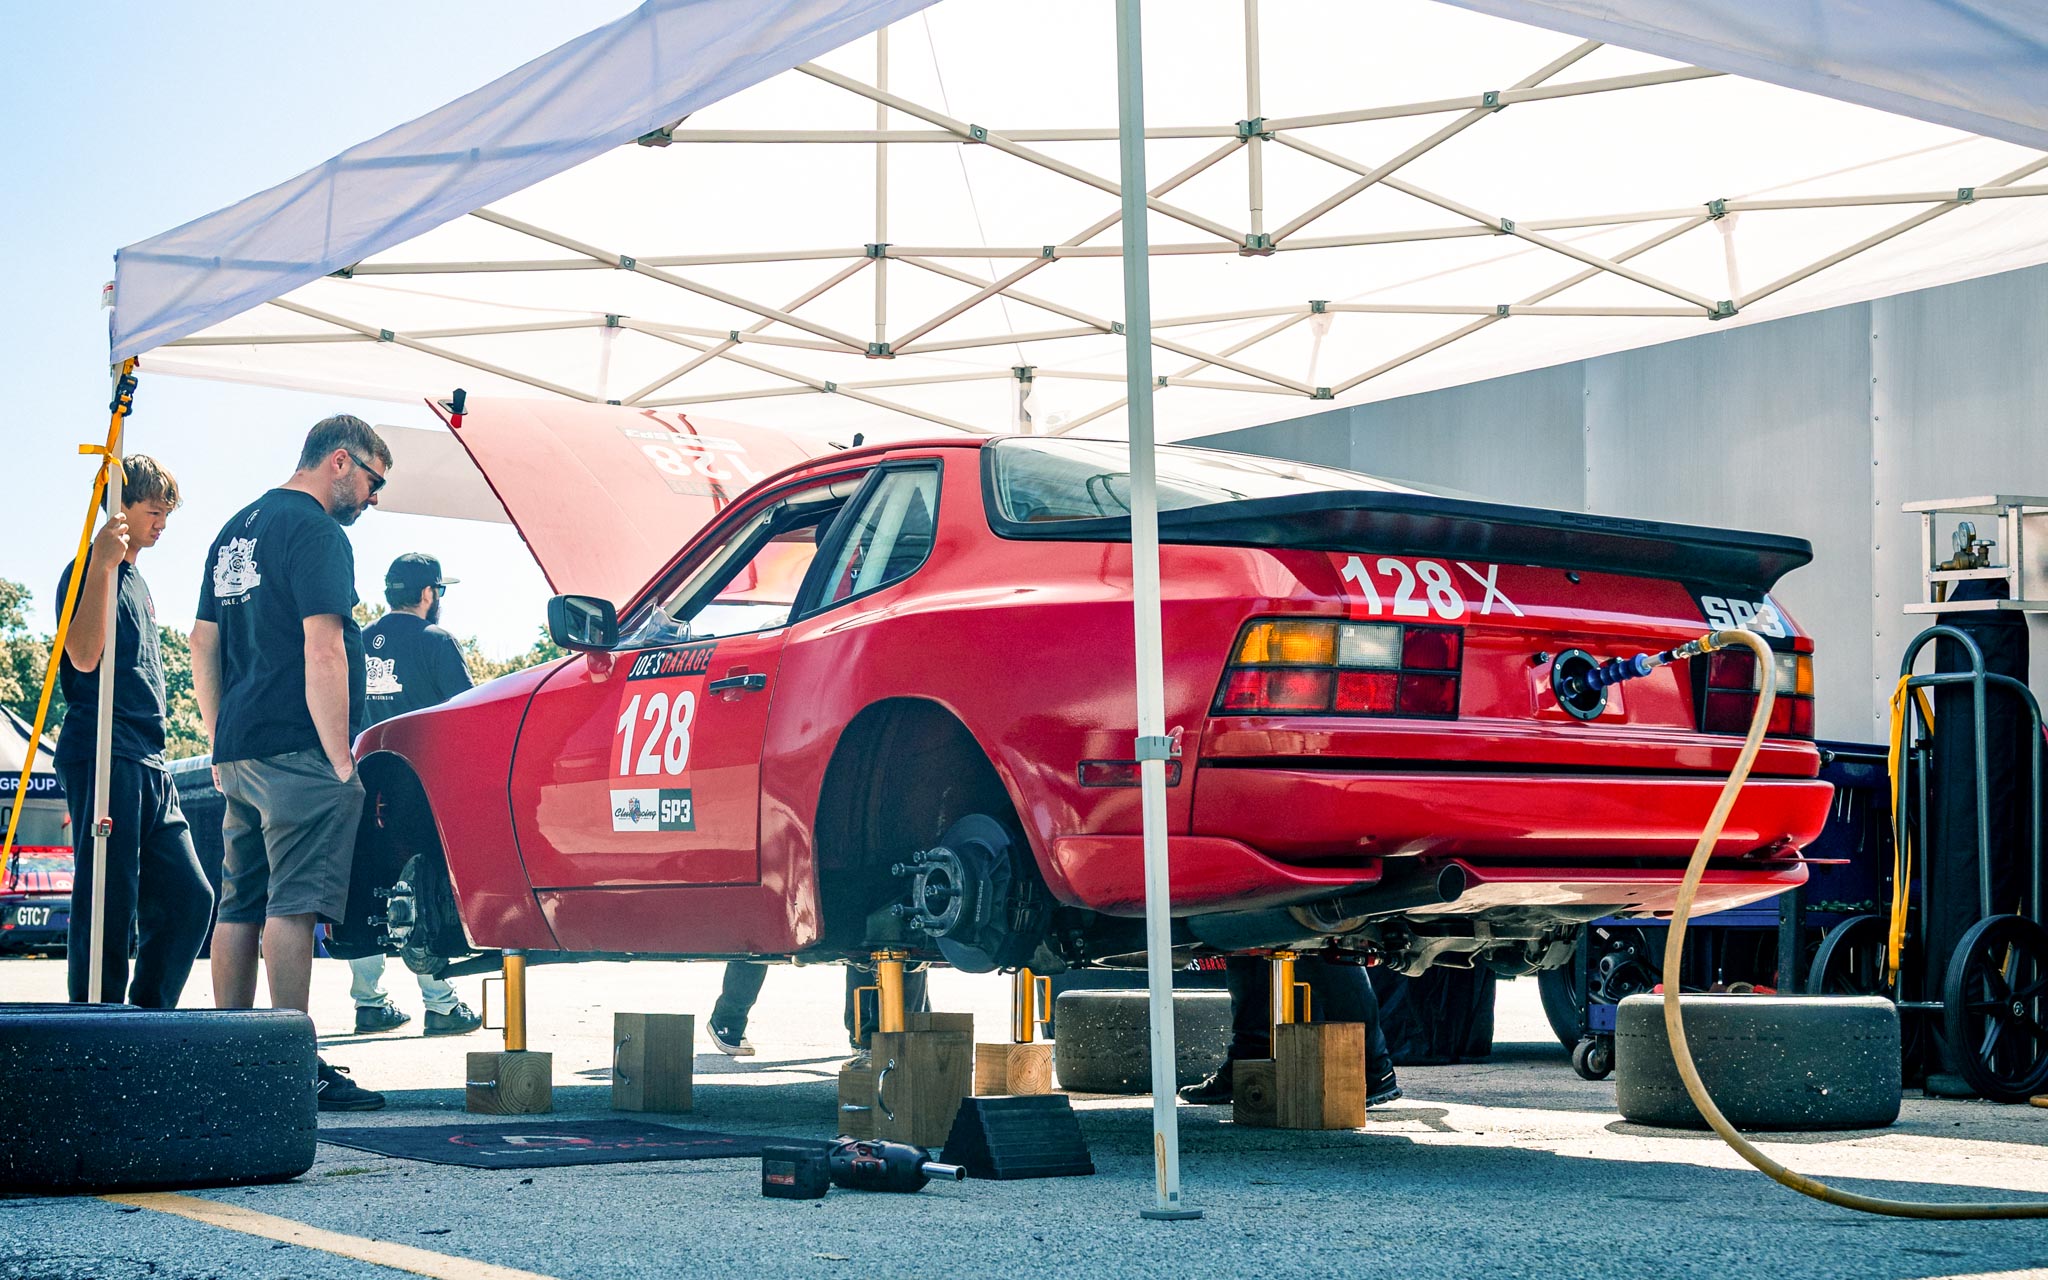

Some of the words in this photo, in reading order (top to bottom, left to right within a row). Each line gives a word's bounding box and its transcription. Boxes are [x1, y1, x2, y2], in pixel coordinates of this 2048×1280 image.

[1560, 514, 1660, 533] PORSCHE
[1341, 556, 1464, 620] 128
[1701, 595, 1786, 639] SP3
[616, 690, 696, 776] 128
[661, 799, 691, 823] SP3
[17, 906, 41, 925] GTC
[42, 907, 50, 925] 7
